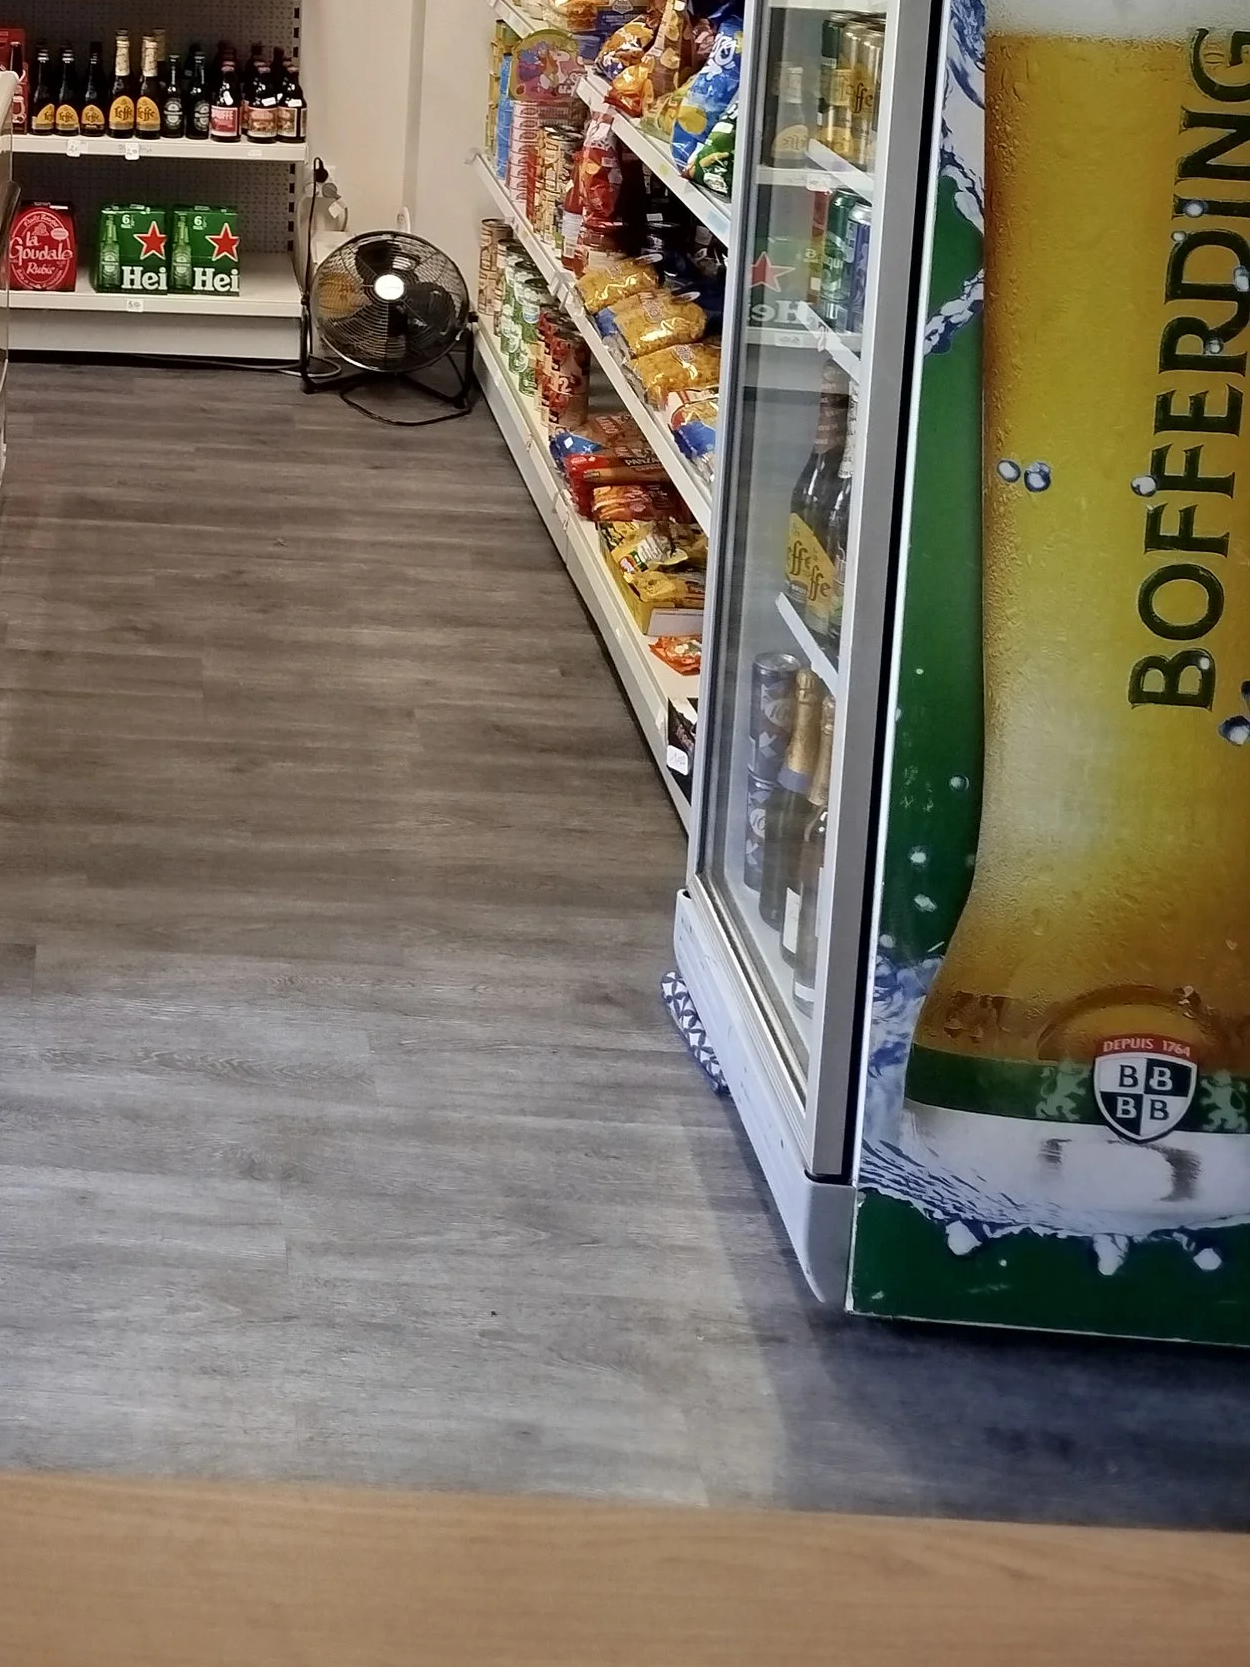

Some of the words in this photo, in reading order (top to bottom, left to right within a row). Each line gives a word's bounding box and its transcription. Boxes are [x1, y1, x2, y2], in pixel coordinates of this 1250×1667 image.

[114, 105, 133, 120] Leffe
[121, 214, 131, 225] 6
[193, 215, 203, 226] 6
[8, 237, 74, 266] Goudale
[121, 265, 168, 291] Hei
[193, 266, 240, 292] Hei
[1127, 27, 1250, 711] BOFFERDING
[1103, 1038, 1154, 1052] DEPUIS
[1163, 1040, 1191, 1057] 1764
